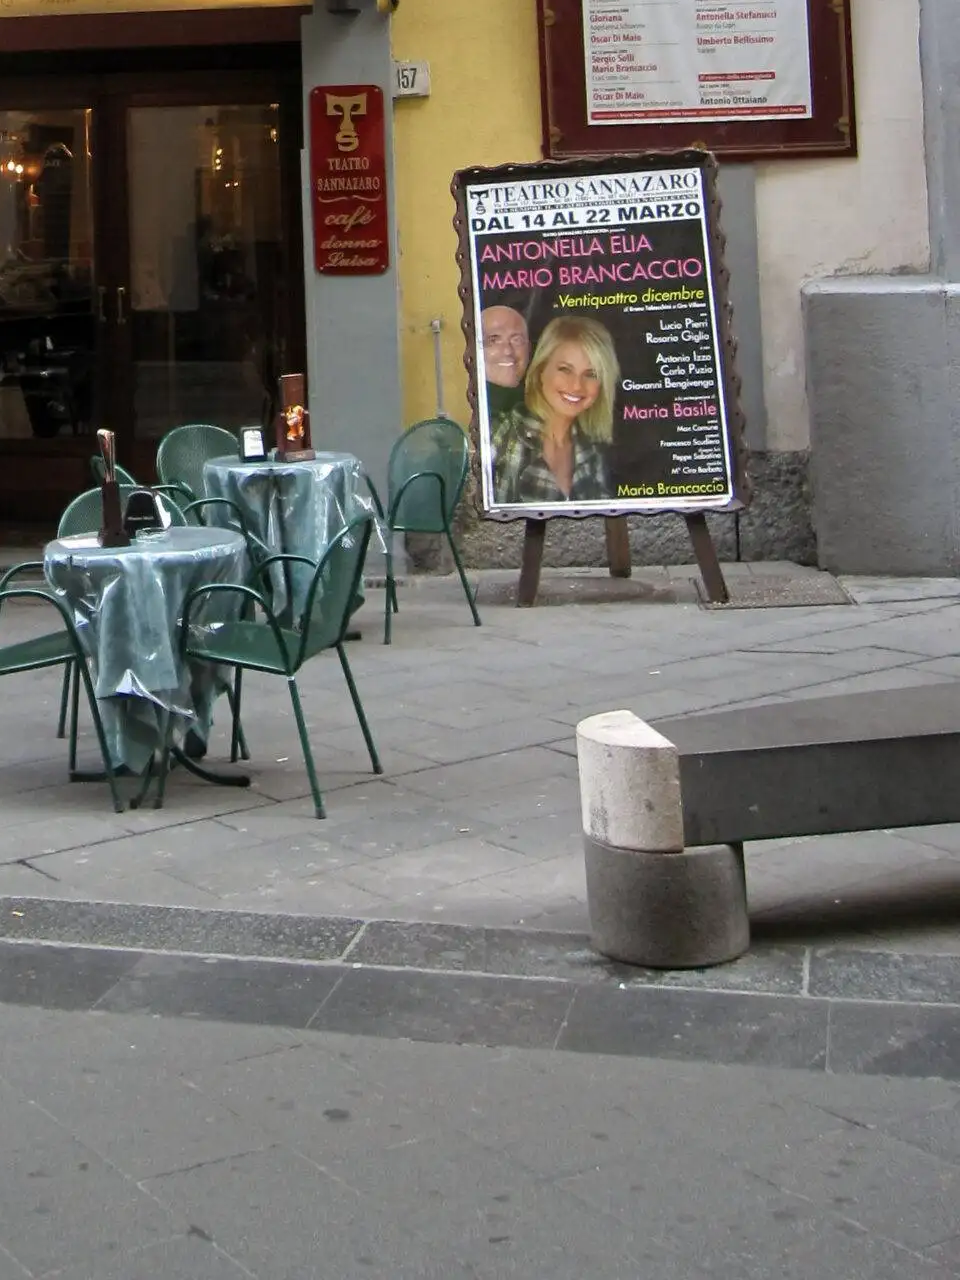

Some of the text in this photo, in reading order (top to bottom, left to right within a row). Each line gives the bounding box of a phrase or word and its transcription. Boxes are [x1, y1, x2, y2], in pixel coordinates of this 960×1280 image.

[696, 12, 735, 21] Antonella
[697, 36, 732, 45] Umberto
[397, 67, 418, 89] 157
[327, 157, 370, 171] TEATRO
[317, 176, 380, 192] SANNAZARO
[491, 182, 570, 204] TEATRO
[575, 171, 698, 198] SANNAZARO
[472, 214, 515, 232] DAL
[522, 213, 546, 228] 14
[552, 210, 580, 226] AL
[586, 208, 611, 223] 22
[618, 201, 701, 221] MARZO
[321, 233, 382, 250] donna
[480, 233, 653, 264] ANTONELLA ELIA
[325, 252, 380, 267] Luisa
[482, 257, 703, 291] MARIO BRANCACCIO
[559, 292, 638, 309] Ventiquattro
[642, 285, 705, 304] dicembre
[660, 320, 683, 331] Lucio
[646, 330, 710, 344] Rosario Giglio
[656, 350, 712, 364] Antonio Izzo
[660, 363, 713, 376] Carlo Puzio
[622, 377, 714, 391] Giovanni Bengivenga
[623, 399, 717, 420] Maria Basile
[660, 440, 691, 448] Francesco
[618, 482, 724, 497] Mario Brancaccio
